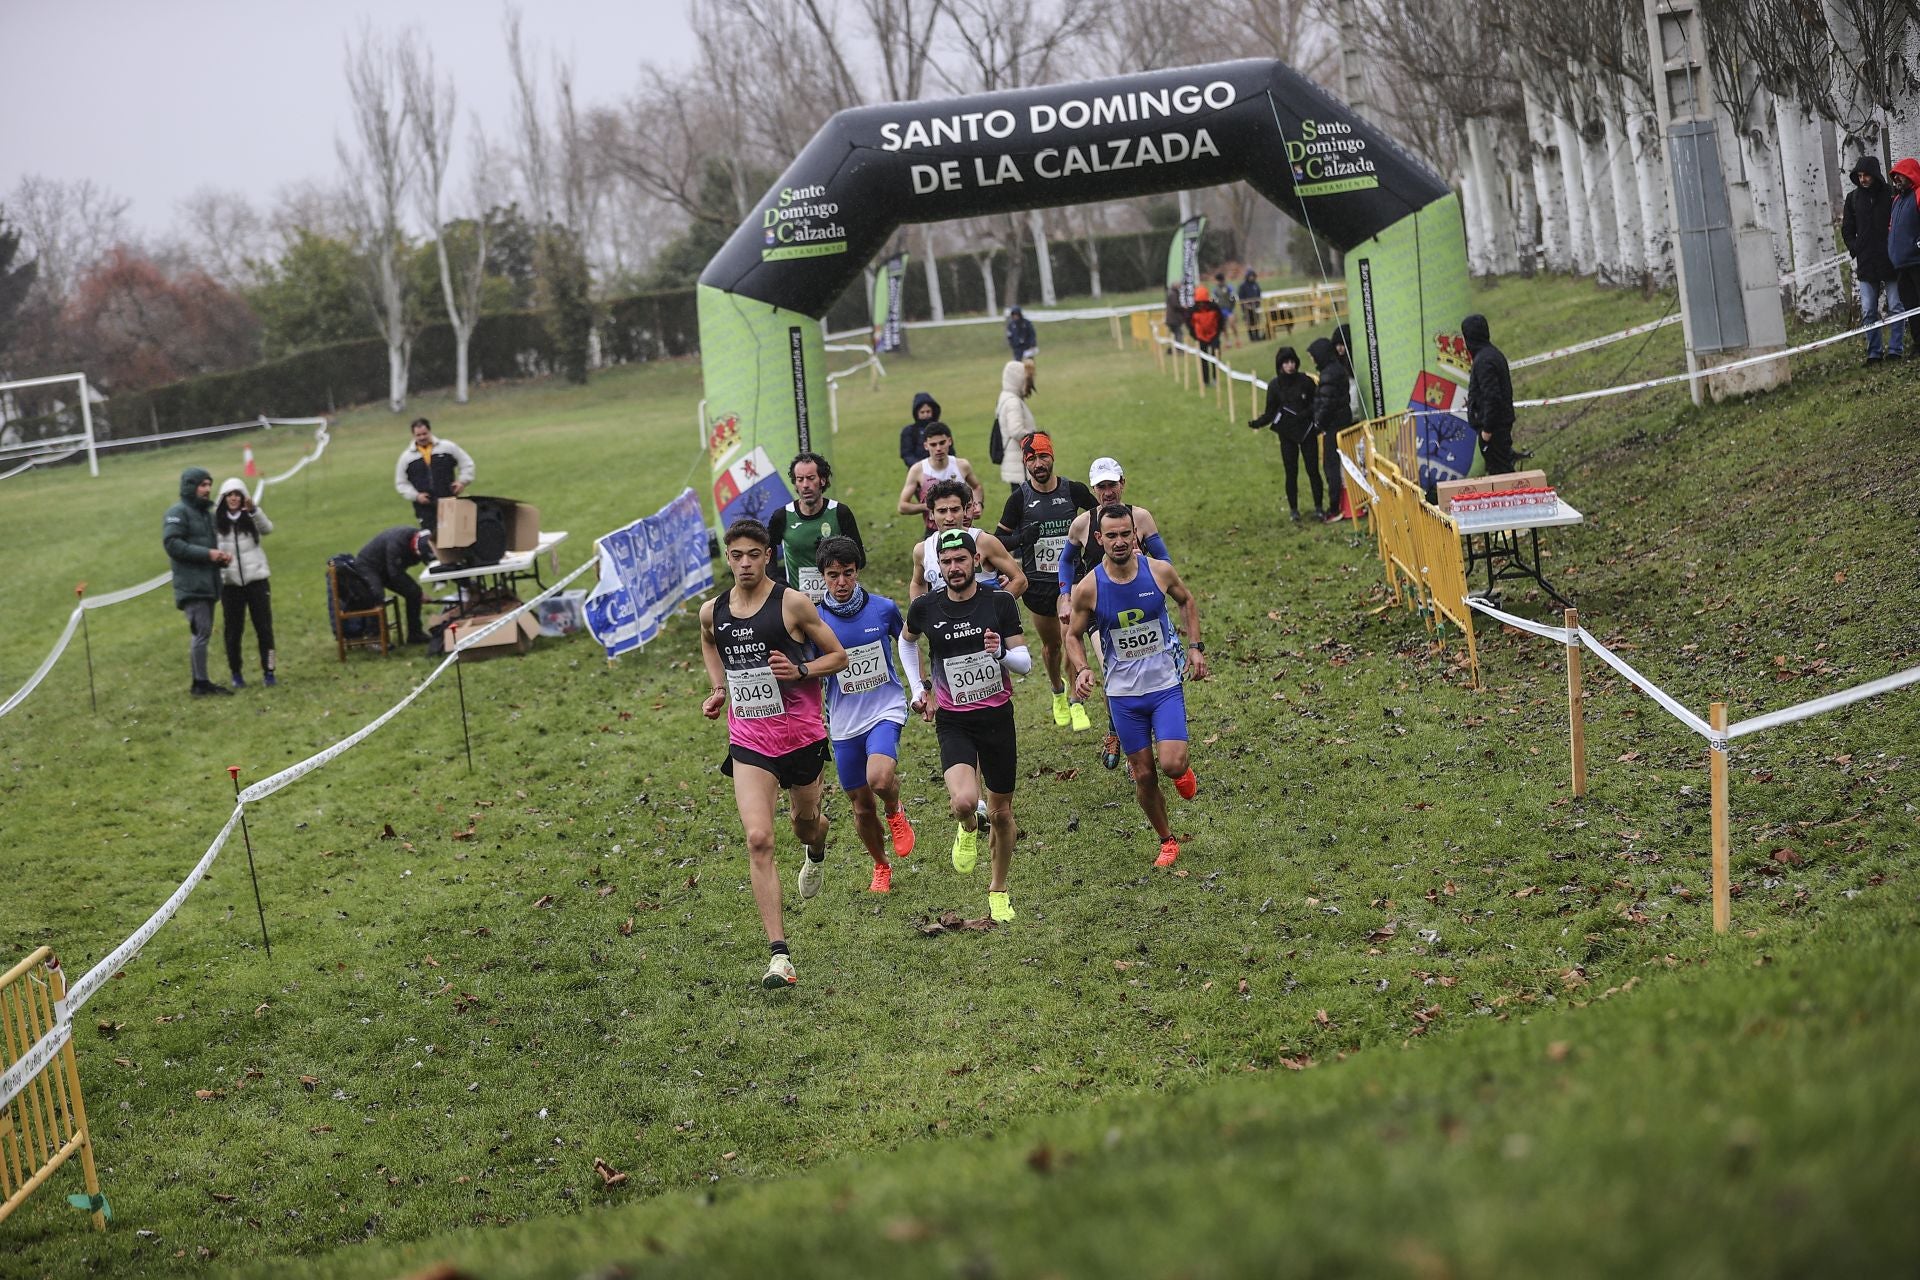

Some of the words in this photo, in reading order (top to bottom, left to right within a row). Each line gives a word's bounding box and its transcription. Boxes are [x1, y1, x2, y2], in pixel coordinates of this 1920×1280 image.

[880, 109, 1016, 151] SANTO
[1029, 81, 1236, 134] DOMINGO
[1301, 119, 1352, 141] Santo
[1286, 136, 1366, 162] Domingo
[910, 161, 962, 195] DE
[974, 154, 1024, 188] LA
[1033, 128, 1220, 179] CALZADA
[1305, 156, 1376, 179] Calzada
[779, 184, 826, 207] Santo
[1299, 178, 1375, 194] AYUNTAMIENTO
[763, 202, 839, 228] Domingo
[776, 222, 846, 243] Calzada
[766, 243, 844, 259] YUNTAMIENTO
[1055, 538, 1067, 546] Rio
[1036, 547, 1065, 562] 497
[1117, 608, 1145, 629] R
[731, 627, 754, 638] CUPA
[953, 627, 982, 639] BARCO
[1118, 630, 1159, 650] 5502
[724, 646, 732, 655] O
[733, 642, 766, 655] BARCO
[842, 656, 880, 679] 3027
[953, 665, 995, 688] 3040
[733, 683, 773, 701] 3049
[967, 685, 1002, 702] ATLETISMO
[745, 705, 782, 718] ATLETISMO
